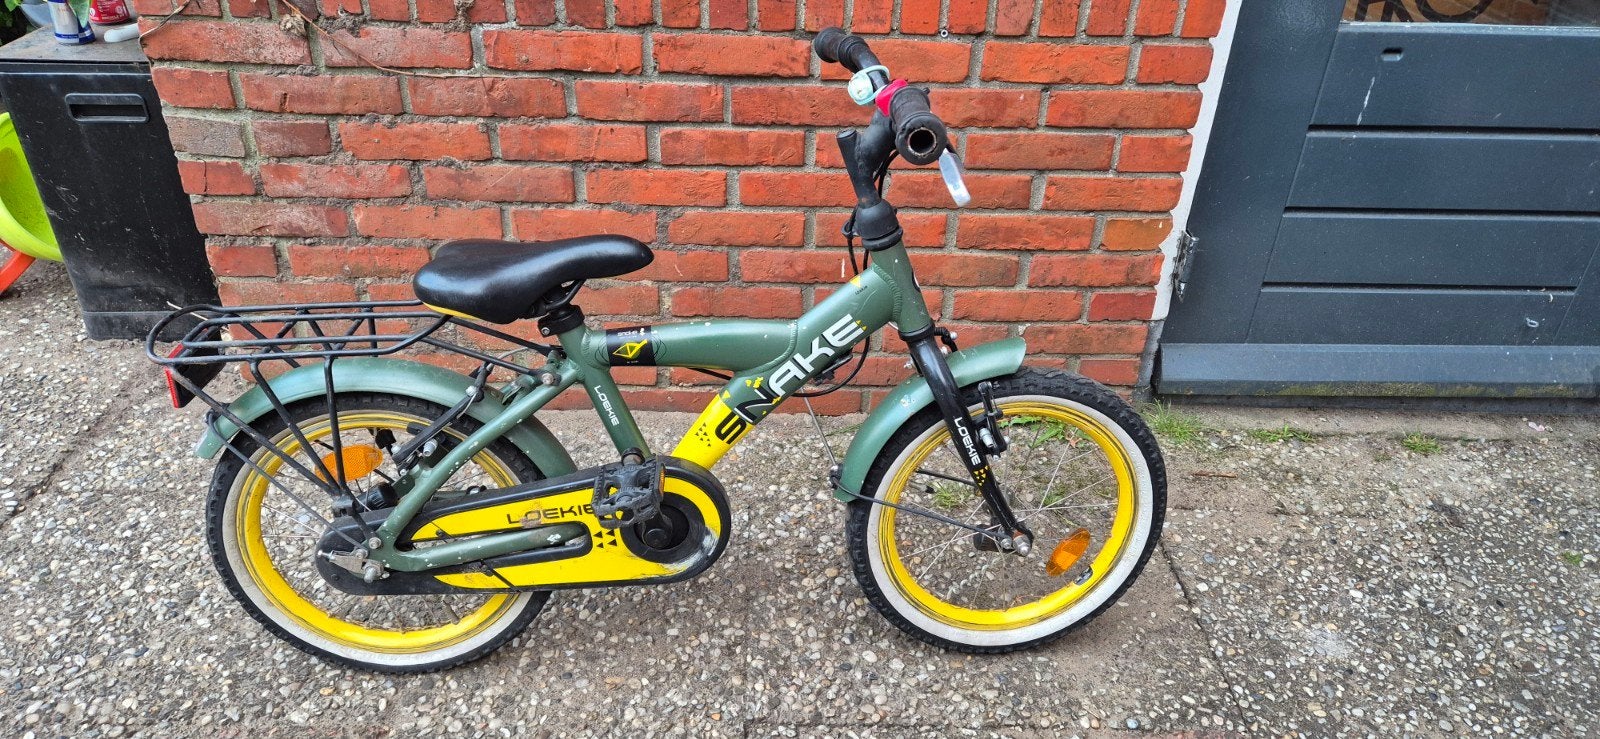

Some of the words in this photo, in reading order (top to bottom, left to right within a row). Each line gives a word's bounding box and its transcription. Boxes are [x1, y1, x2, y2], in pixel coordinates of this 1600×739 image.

[715, 314, 865, 445] SNAKE
[593, 384, 620, 427] LOEKIE
[953, 416, 982, 466] LOEKIE
